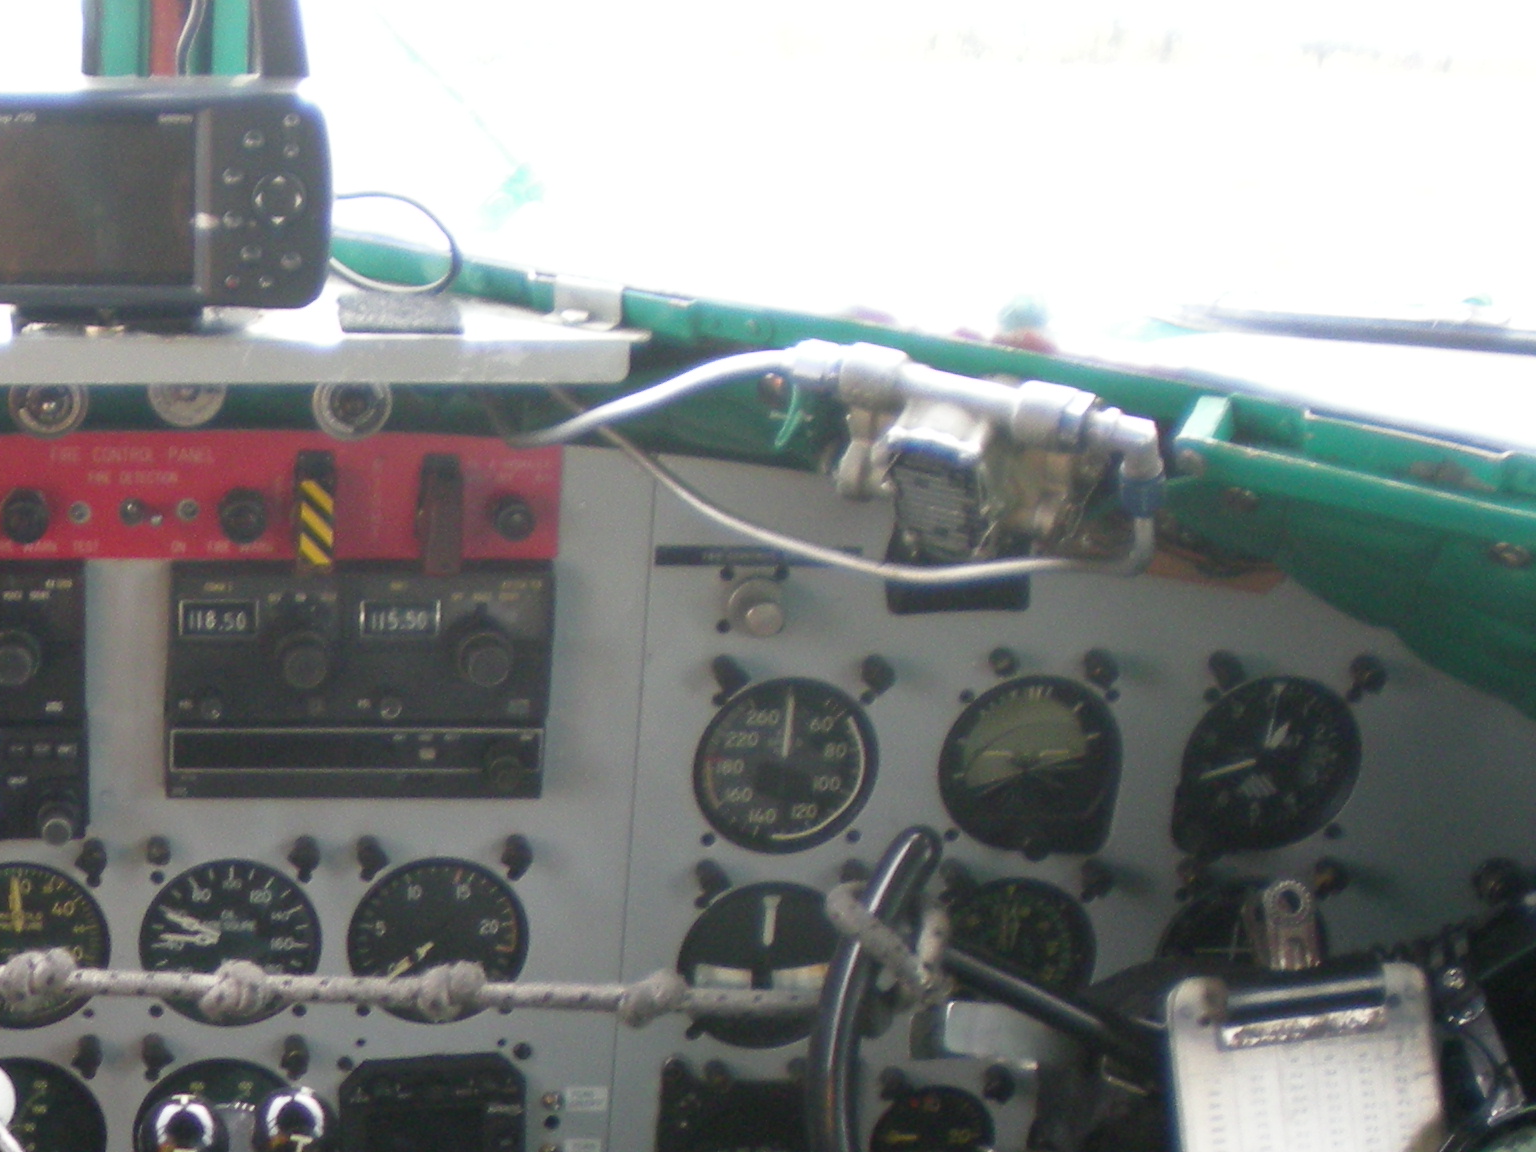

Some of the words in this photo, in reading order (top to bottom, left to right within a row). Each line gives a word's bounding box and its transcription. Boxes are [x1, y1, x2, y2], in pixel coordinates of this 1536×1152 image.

[93, 446, 154, 462] CONTROL
[168, 447, 214, 462] PANEL
[725, 731, 760, 748] 220
[52, 901, 75, 917] 40
